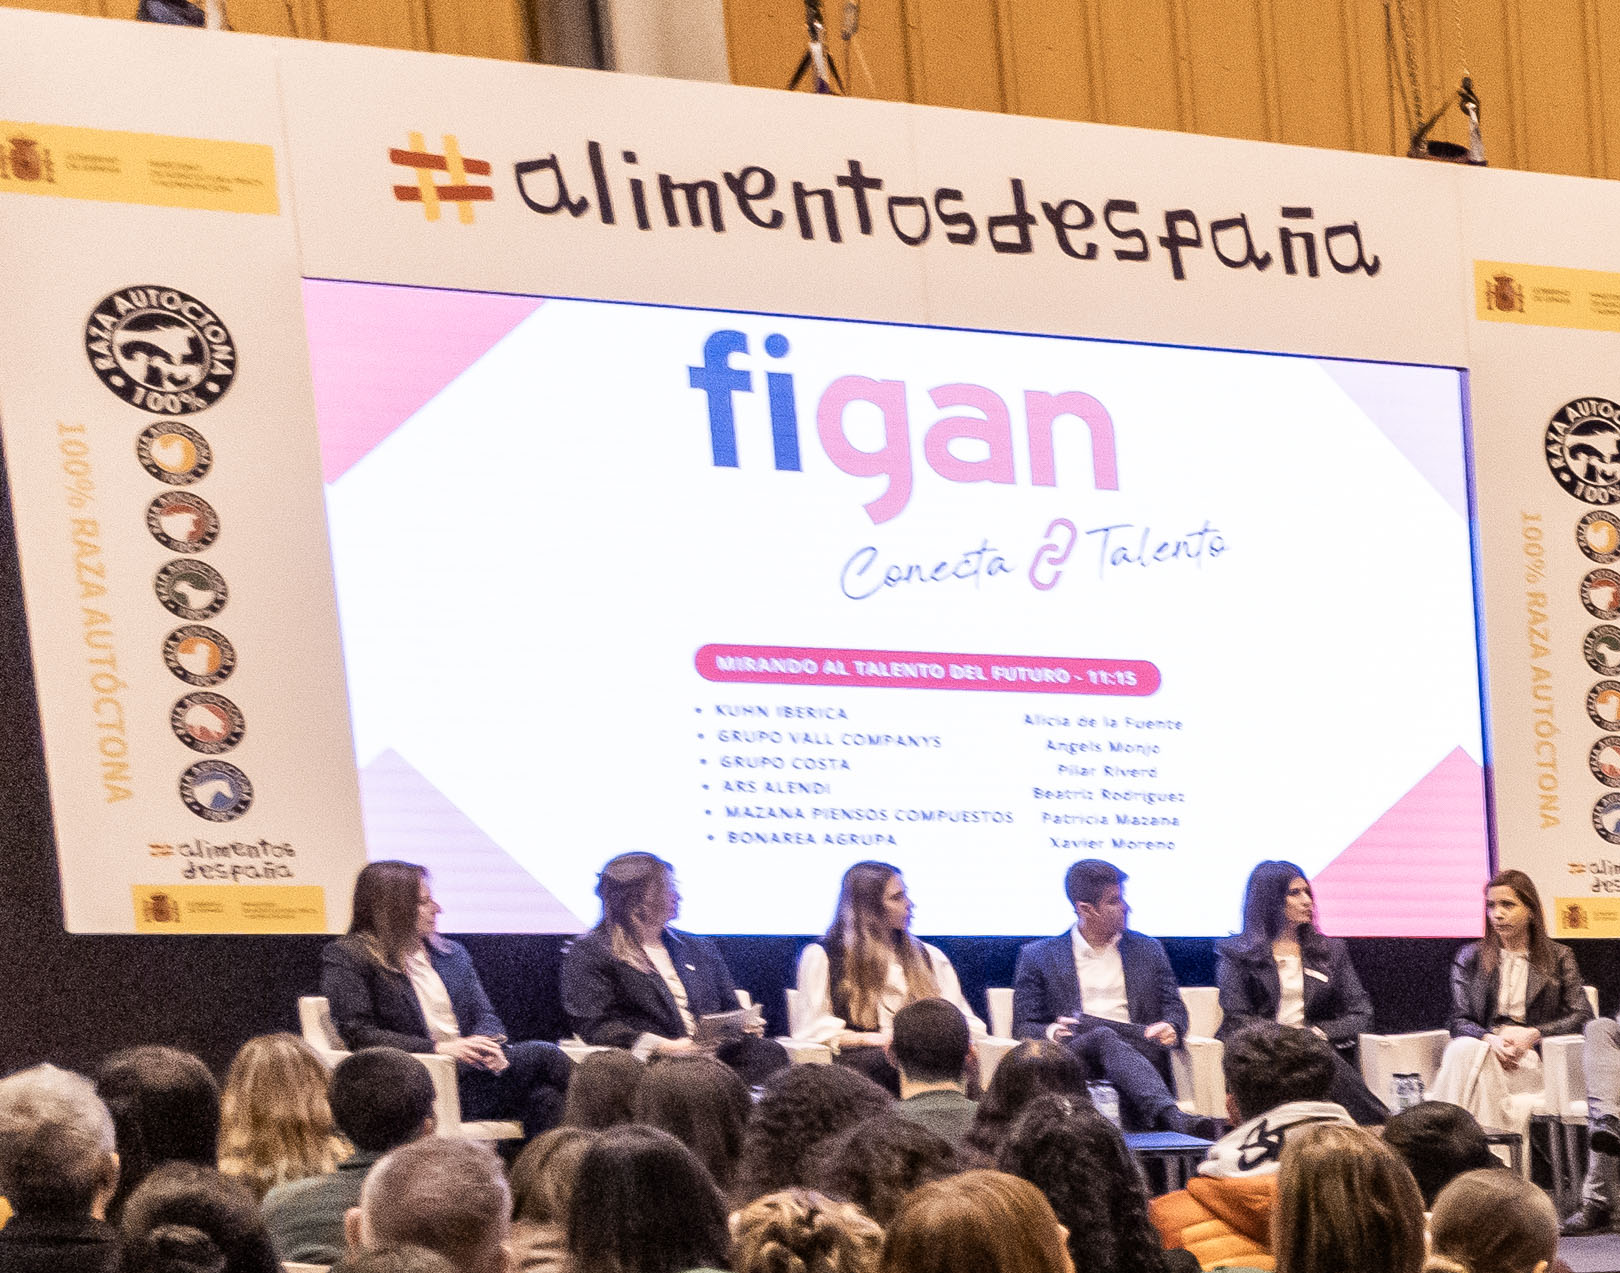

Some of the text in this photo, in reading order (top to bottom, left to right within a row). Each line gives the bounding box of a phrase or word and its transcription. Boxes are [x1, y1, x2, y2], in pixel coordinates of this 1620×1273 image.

[686, 329, 1120, 525] figan
[1521, 511, 1546, 584] 100%
[839, 520, 1231, 601] Conecta Talento
[57, 422, 134, 804] 100% RAZA AUTÓCTONA
[1526, 591, 1551, 660] RAZA
[715, 655, 818, 675] MIRANDO
[823, 659, 850, 676] AL
[852, 660, 946, 679] TALENTO
[949, 663, 988, 681] DEL
[991, 665, 1071, 684] FUTURO
[714, 704, 770, 718] KUHN
[1023, 714, 1071, 728] Alicia
[1076, 715, 1097, 728] de
[1125, 716, 1184, 731] Fuente
[716, 730, 942, 749] GRUPO VALL COMPANYS
[719, 756, 851, 771] GRUPO COSTA
[1057, 764, 1096, 777] Pilar
[723, 780, 832, 796] ARS ALENDI
[1032, 787, 1094, 800] Beatriz
[724, 806, 1014, 824] MAZANA PIENSOS COMPUESTOS
[1040, 811, 1180, 827] Patricia Mazana
[726, 831, 898, 847] BONAREA AGRUPA
[1049, 837, 1176, 850] Xavier Moreno
[182, 862, 295, 883] despaña
